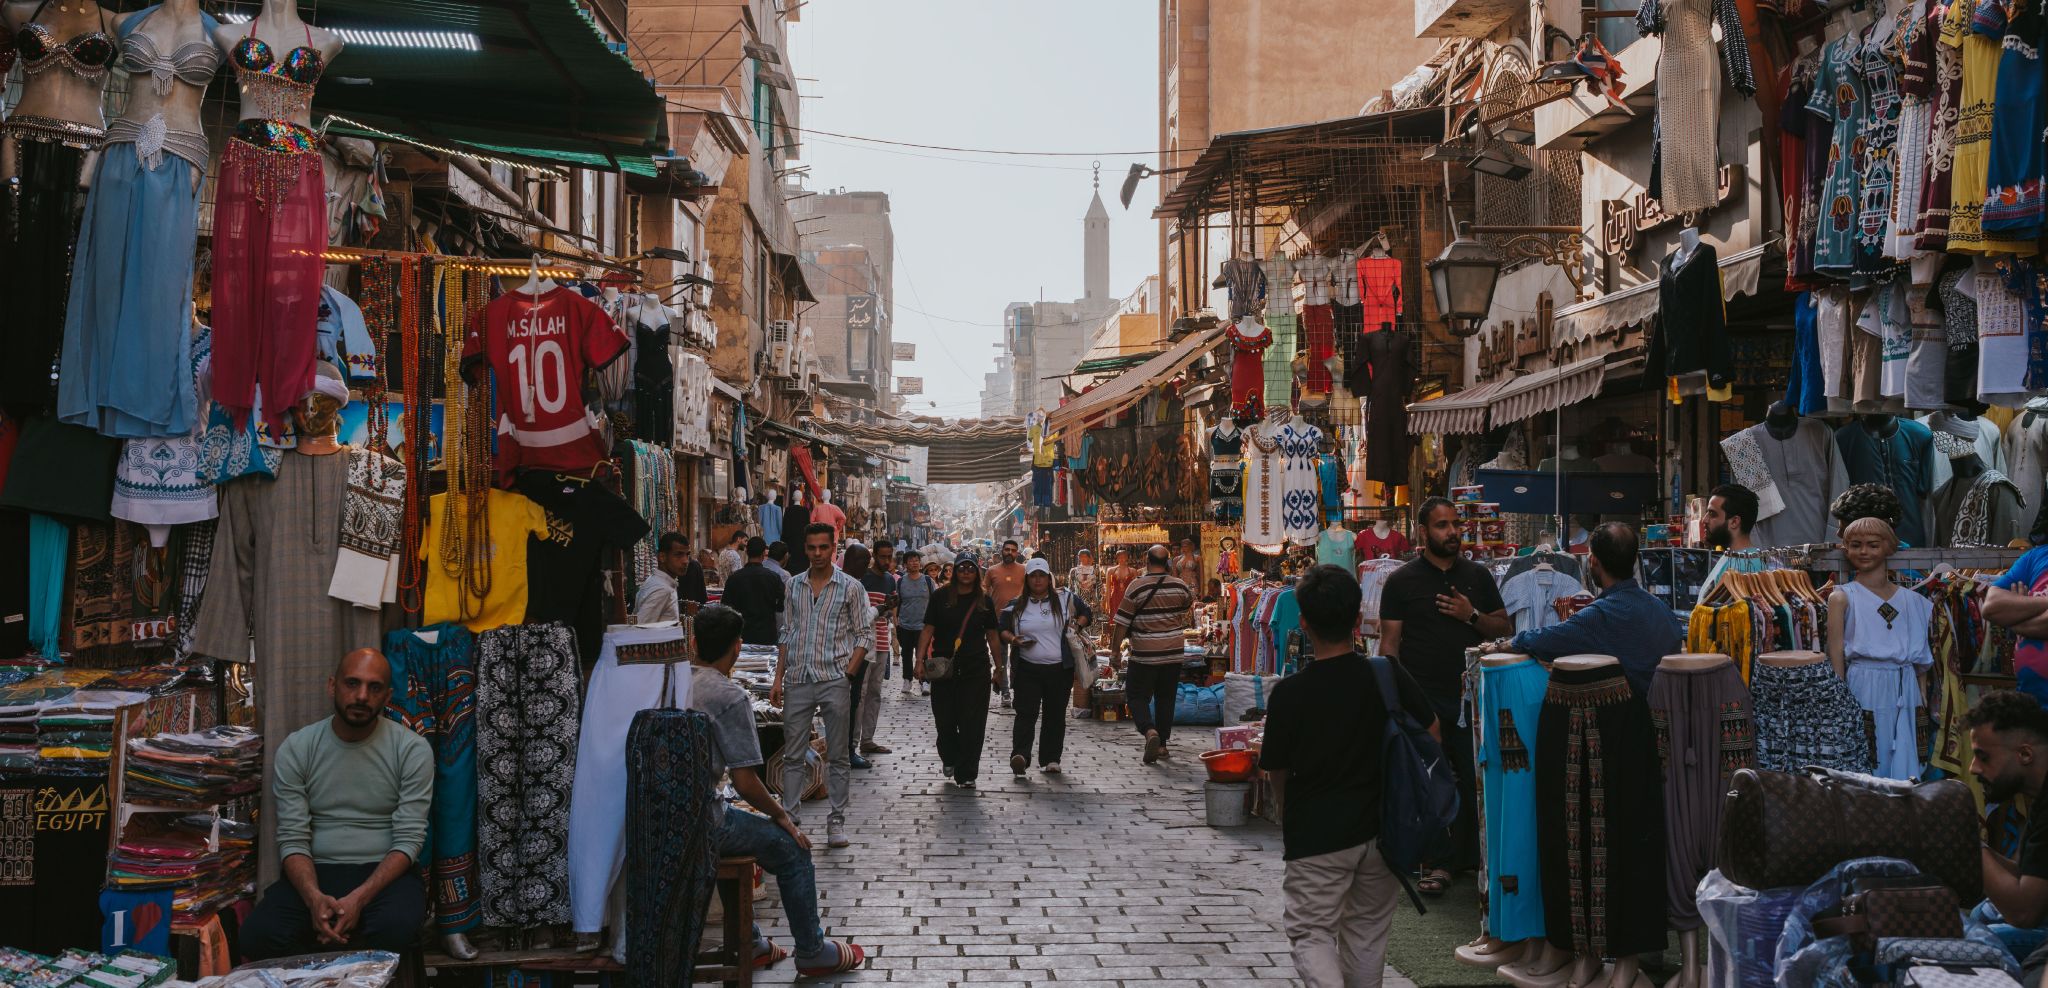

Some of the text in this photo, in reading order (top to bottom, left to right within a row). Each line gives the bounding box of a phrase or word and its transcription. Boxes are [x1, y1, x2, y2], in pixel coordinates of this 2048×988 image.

[507, 316, 566, 338] M.SALAH
[508, 340, 567, 415] 10
[36, 812, 107, 832] EGYPT
[110, 909, 128, 947] I
